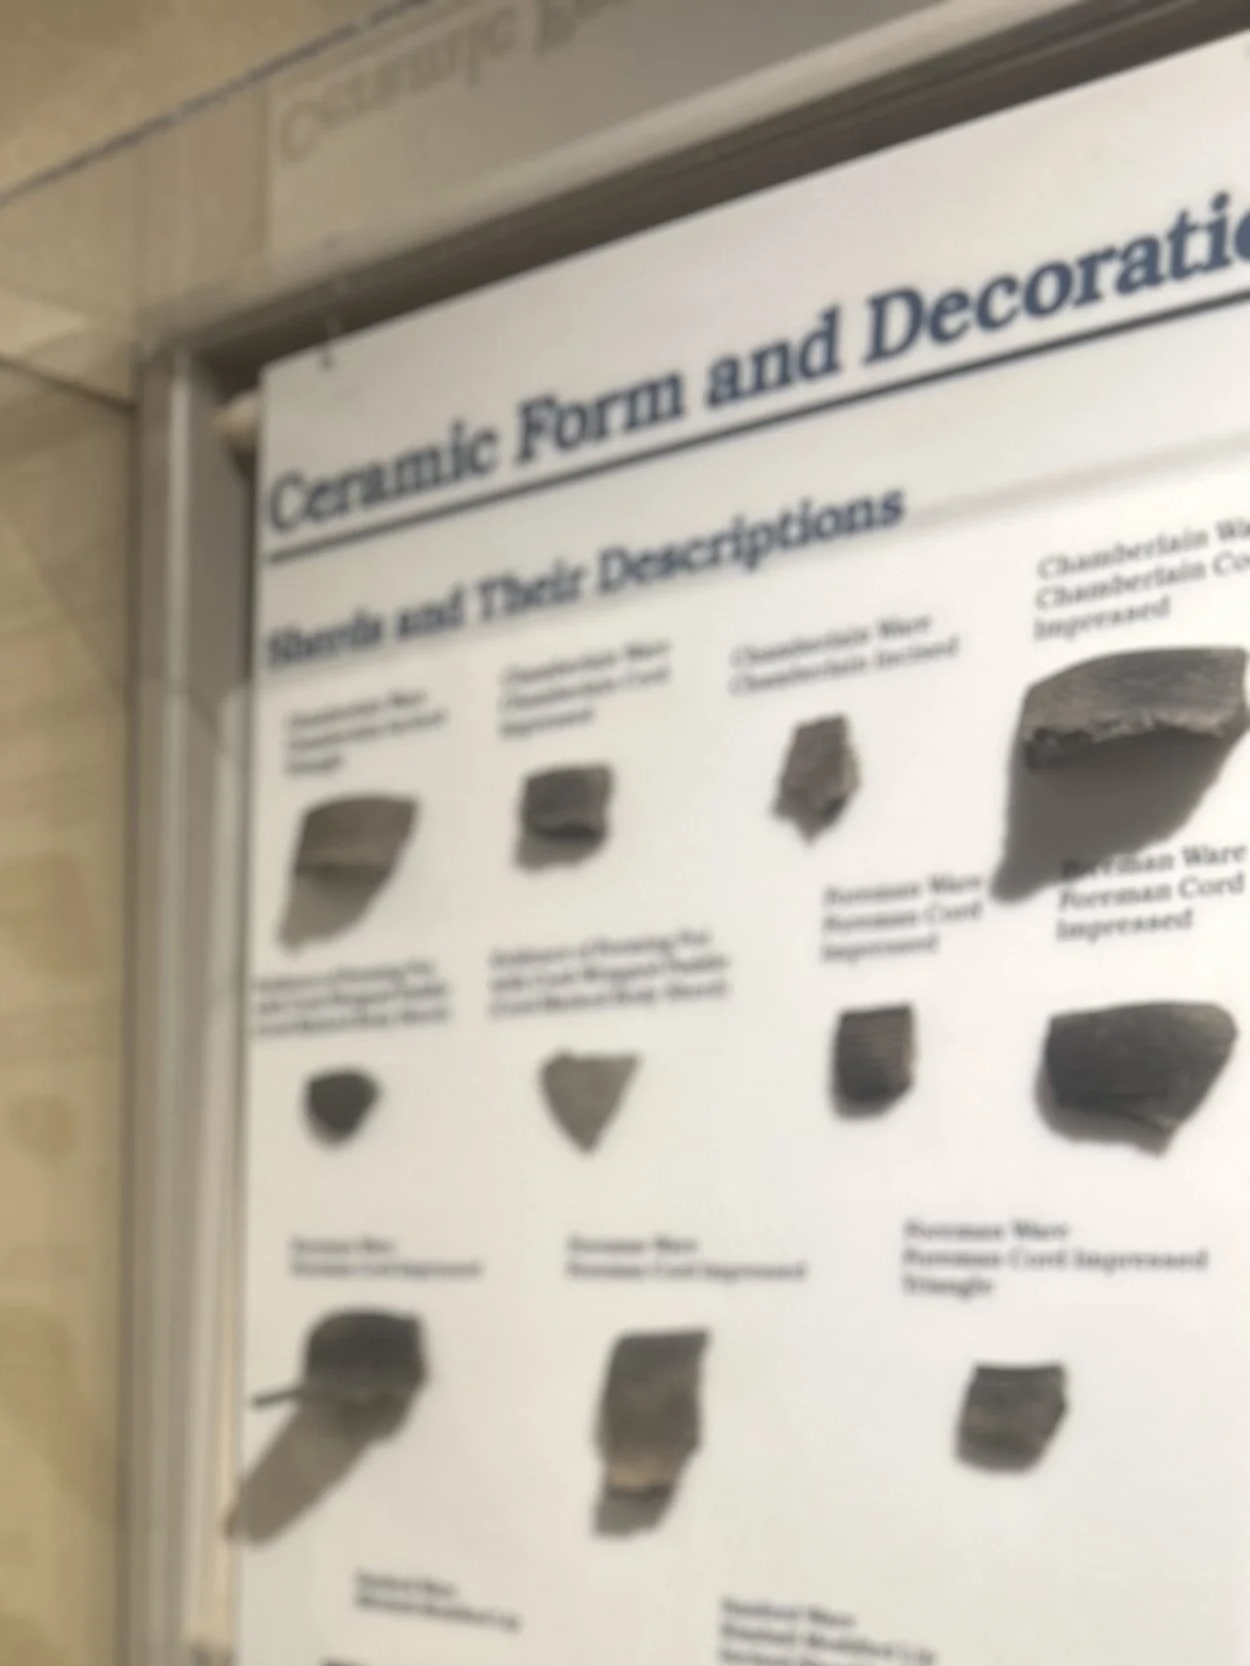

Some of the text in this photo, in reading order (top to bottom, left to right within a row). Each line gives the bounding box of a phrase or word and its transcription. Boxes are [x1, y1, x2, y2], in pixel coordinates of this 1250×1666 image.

[268, 420, 499, 535] Ceramic
[516, 367, 687, 466] Form
[706, 305, 843, 410] and
[396, 582, 464, 643] and
[476, 558, 588, 622] Their
[598, 487, 905, 594] Descriptions
[1034, 557, 1207, 611] Chamberlain
[1037, 526, 1210, 581] Chamberlain
